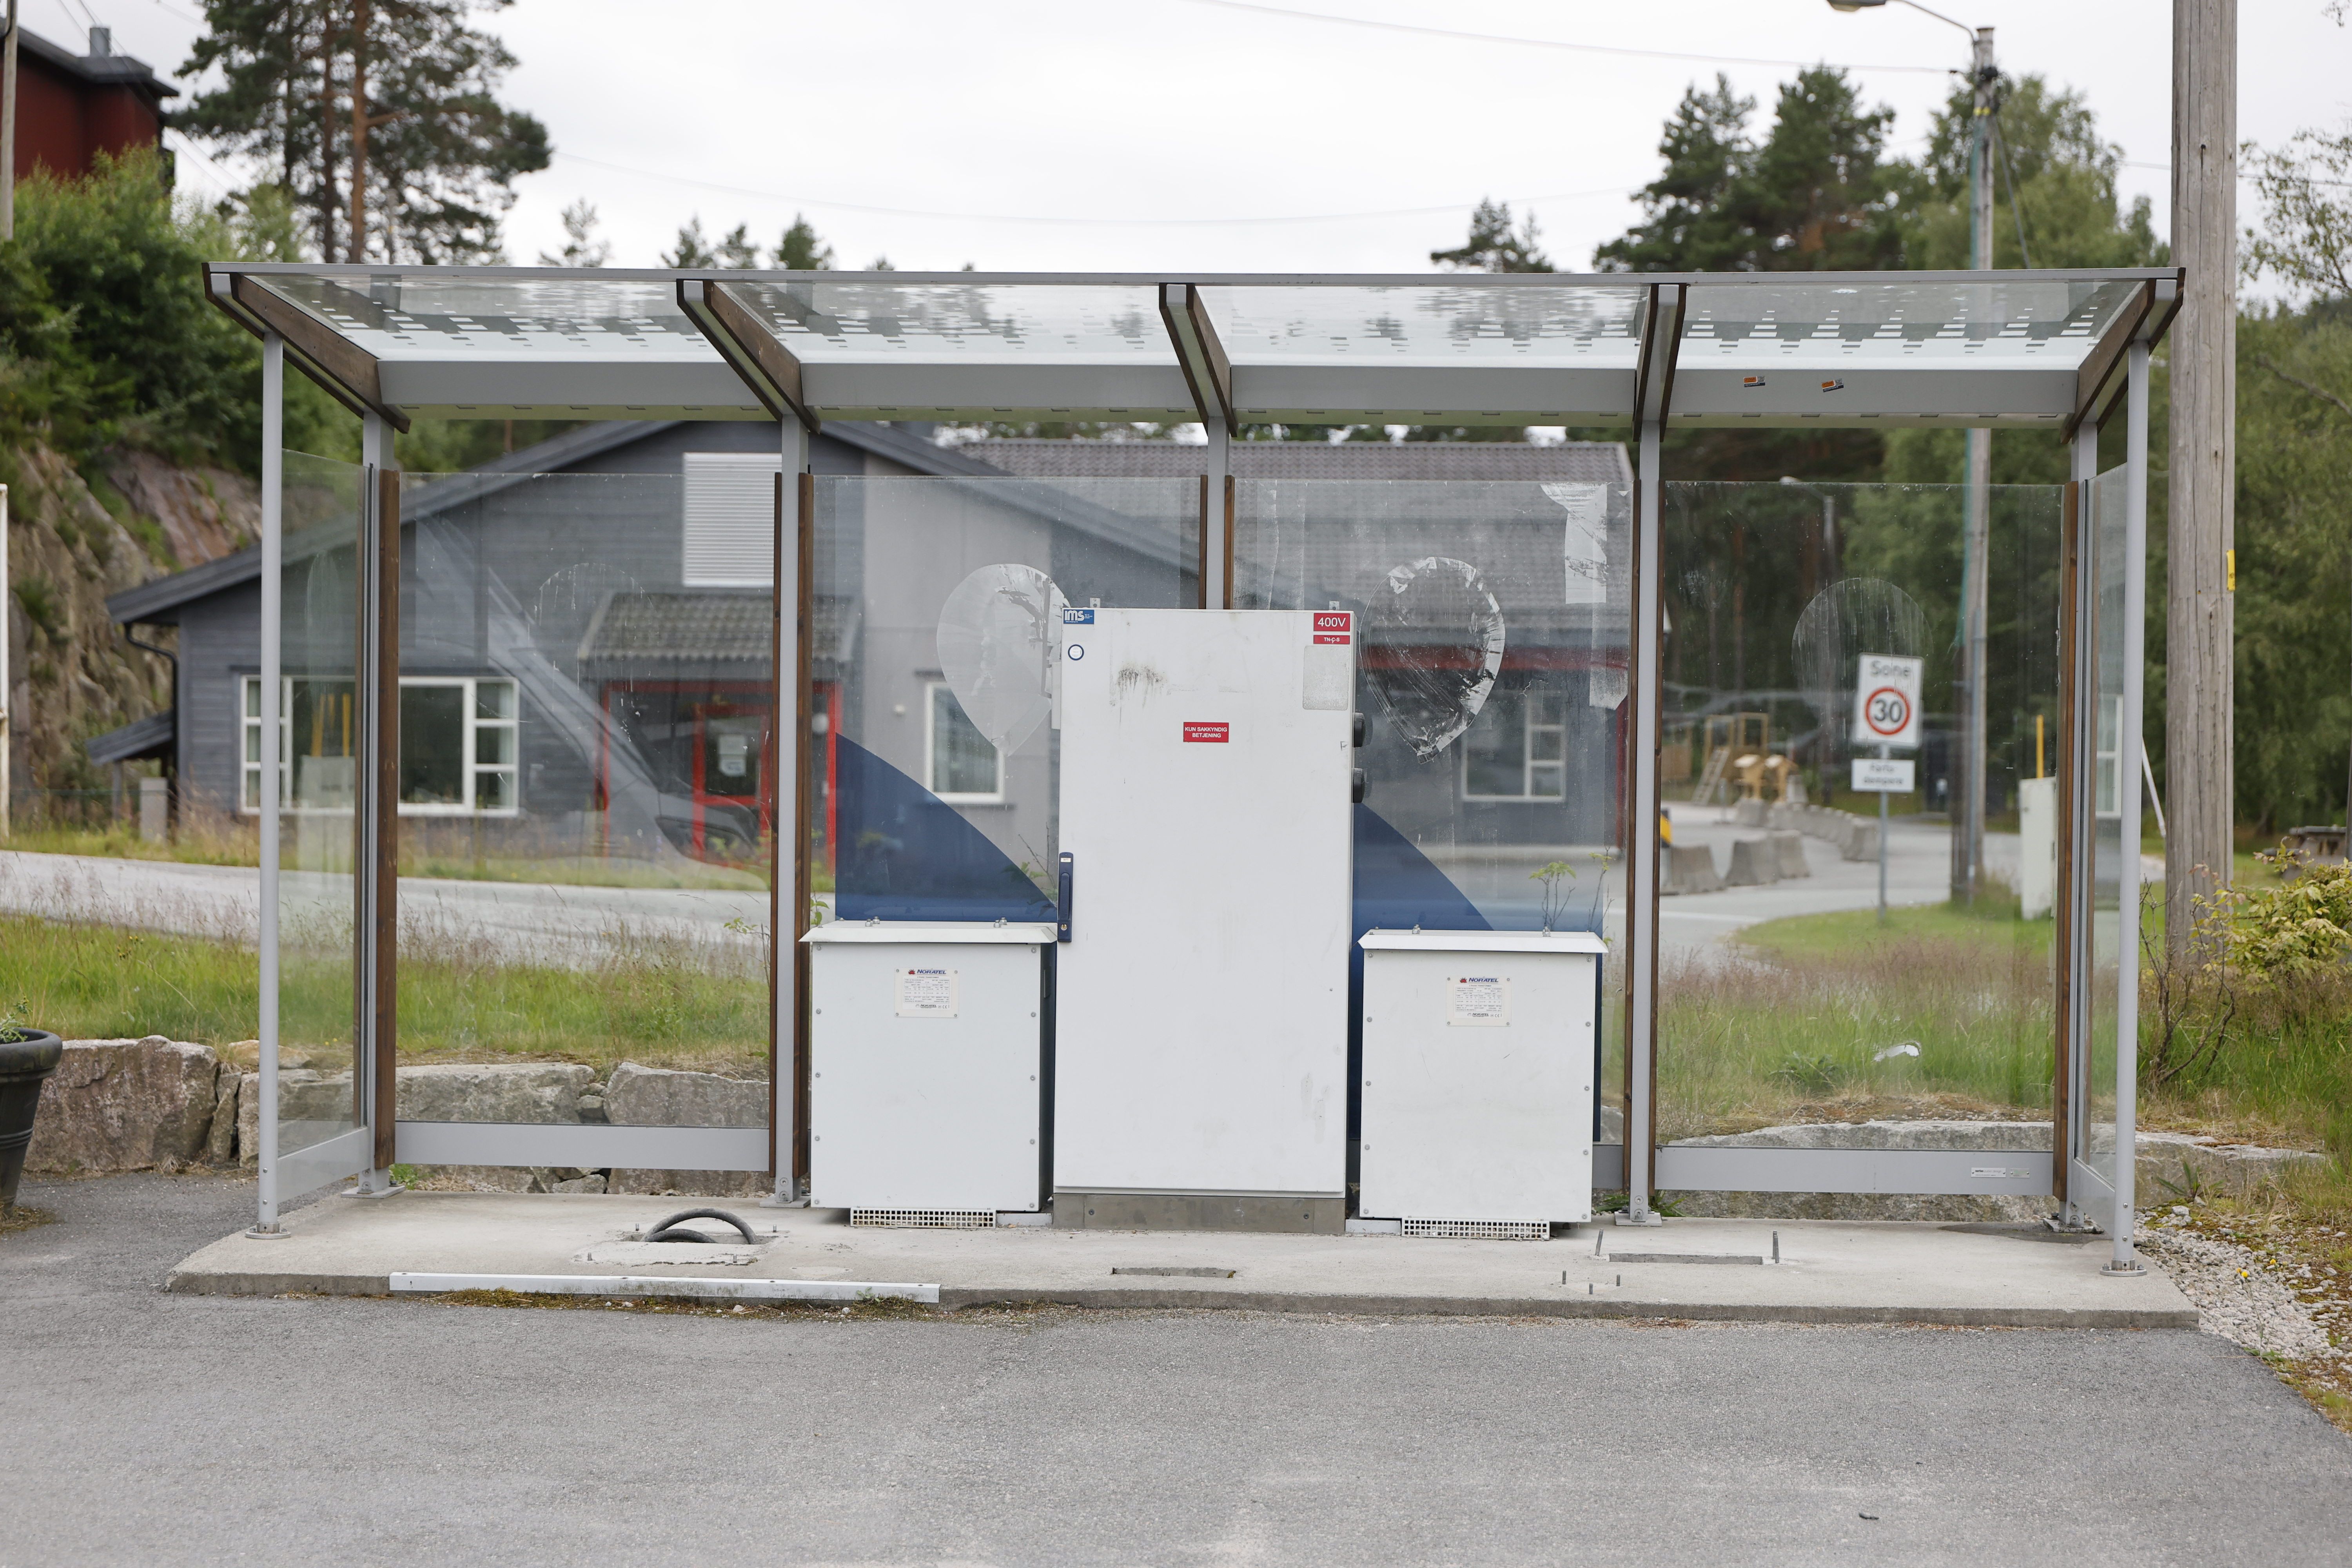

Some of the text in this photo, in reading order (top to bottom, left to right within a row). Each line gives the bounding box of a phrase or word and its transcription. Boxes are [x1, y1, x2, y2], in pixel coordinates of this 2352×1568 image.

[1318, 617, 1346, 627] 400V
[1870, 660, 1911, 677] Sone
[1874, 699, 1902, 722] 30
